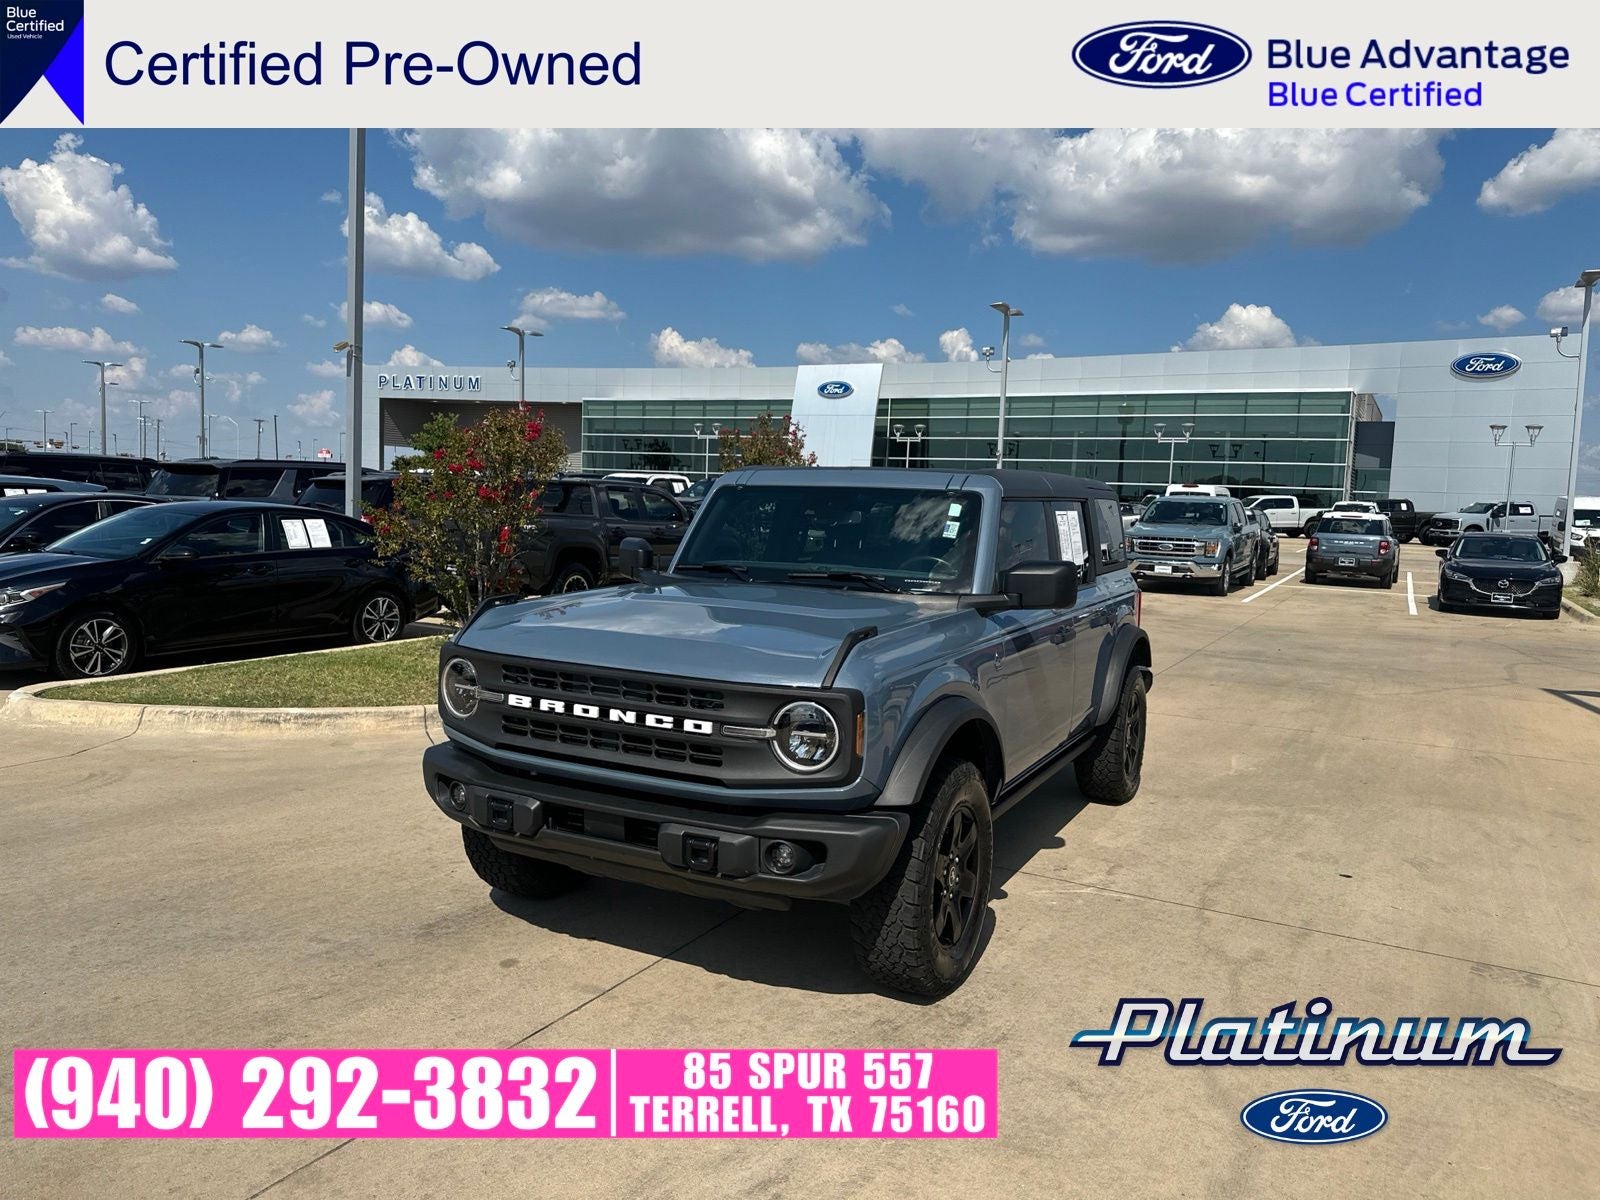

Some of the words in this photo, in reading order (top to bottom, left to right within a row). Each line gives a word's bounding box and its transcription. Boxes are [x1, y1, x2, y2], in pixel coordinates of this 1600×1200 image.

[1465, 356, 1505, 372] Ford
[377, 373, 482, 391] PLATINUM
[824, 383, 845, 394] Ford
[507, 693, 714, 735] BRONCO
